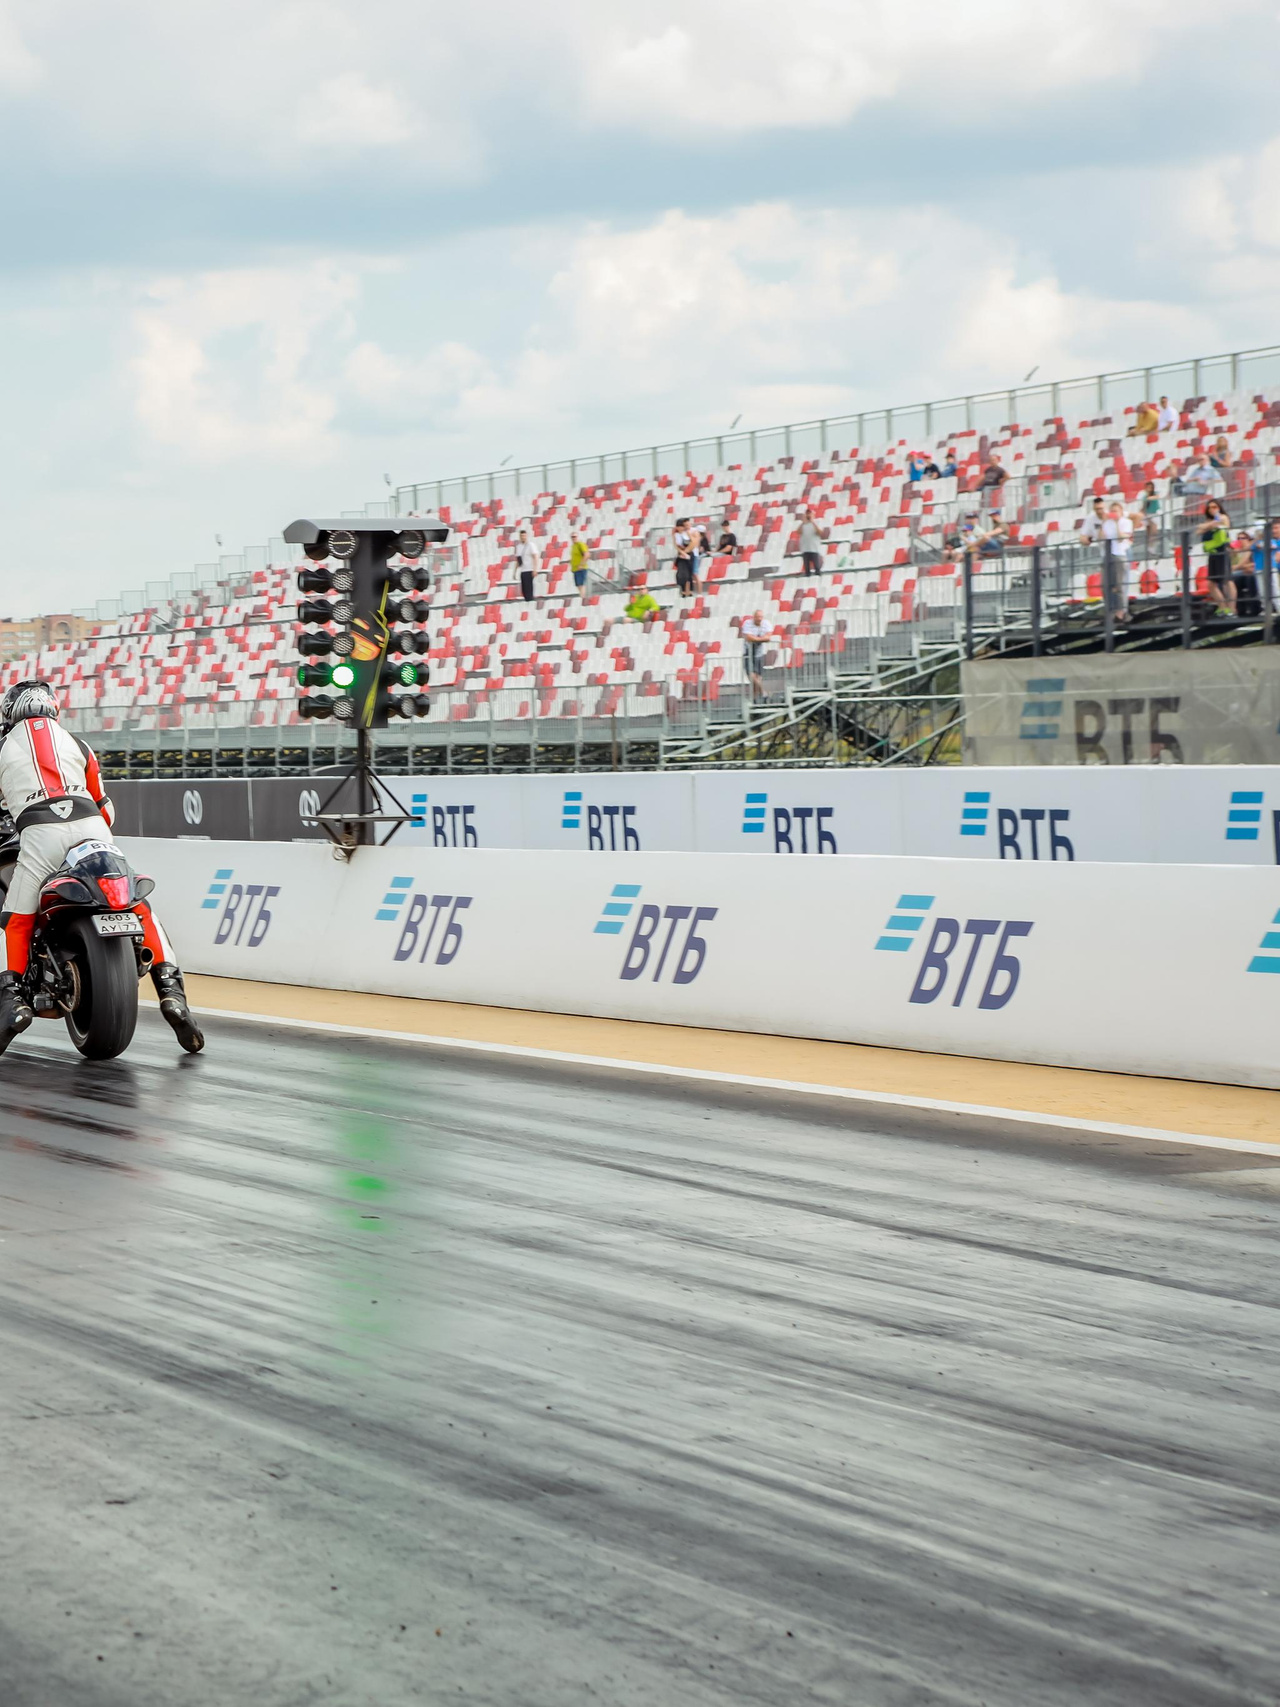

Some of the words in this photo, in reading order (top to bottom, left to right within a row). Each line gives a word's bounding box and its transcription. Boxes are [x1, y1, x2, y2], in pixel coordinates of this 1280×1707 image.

[1074, 697, 1184, 765] ВТБ
[433, 804, 478, 847] ВТБ
[588, 805, 640, 851] ВТБ
[774, 807, 837, 855] ВТБ
[998, 809, 1075, 862] ВТБ
[100, 914, 131, 922] 4603
[214, 884, 281, 947] ВТБ
[393, 894, 473, 966] ВТБ
[619, 904, 719, 985] ВТБ
[909, 916, 1035, 1010] ВТБ
